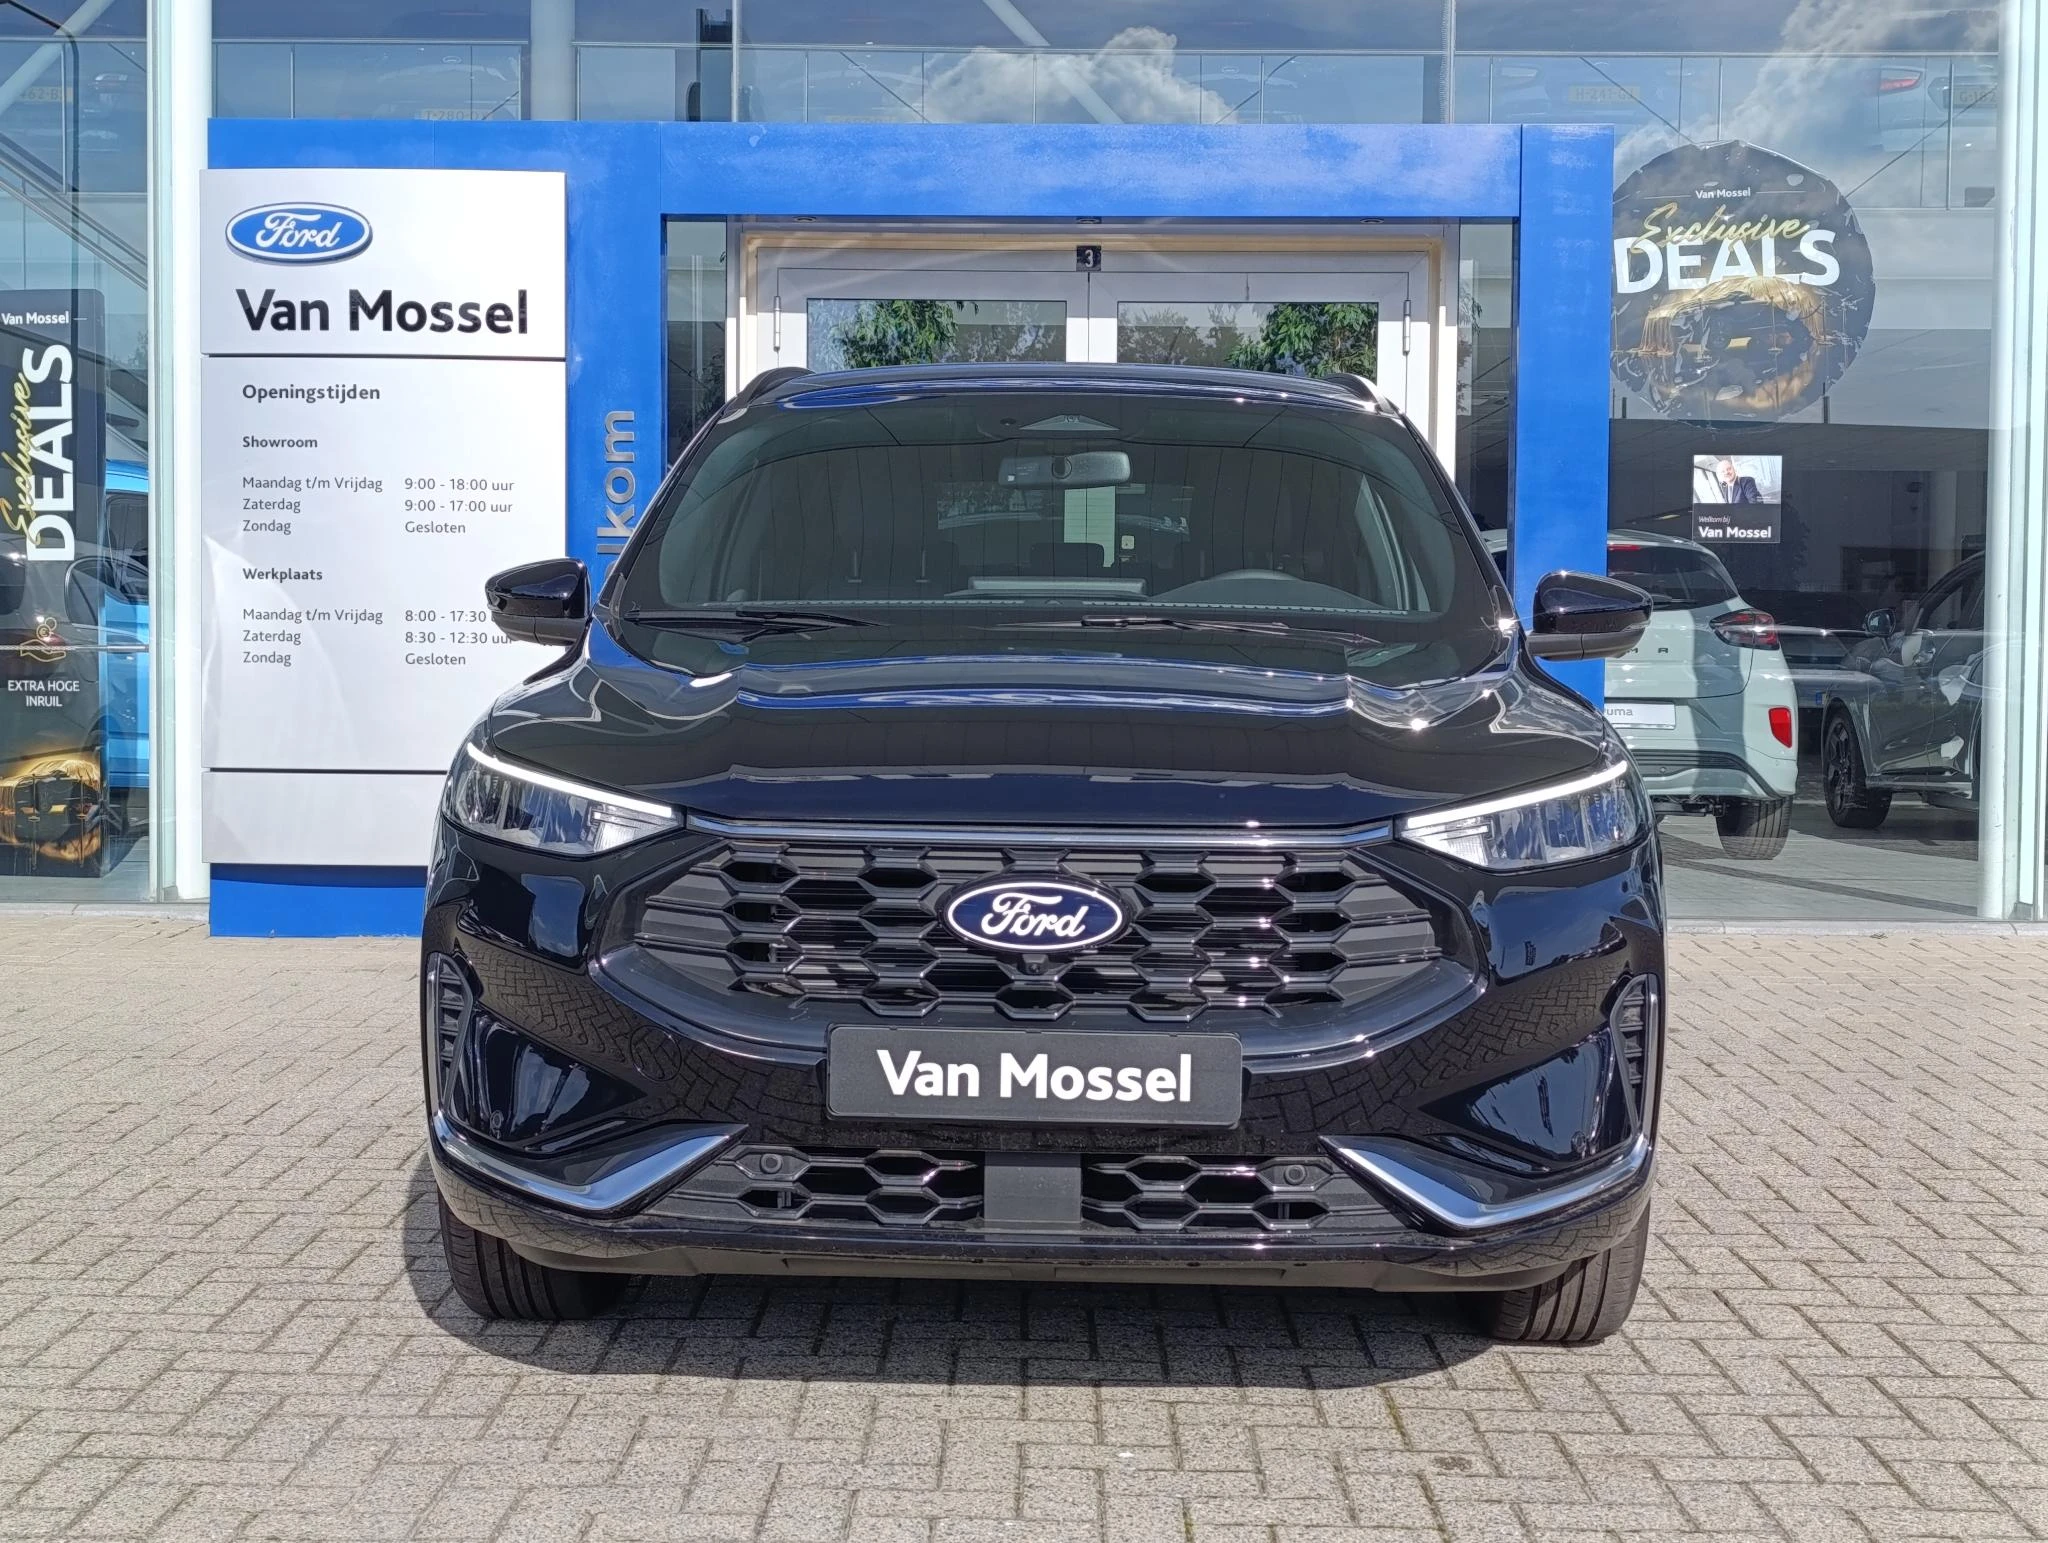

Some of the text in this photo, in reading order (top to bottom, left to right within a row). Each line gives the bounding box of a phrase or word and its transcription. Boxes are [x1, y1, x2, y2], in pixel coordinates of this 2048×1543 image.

[1695, 187, 1751, 200] Van Mossel
[255, 211, 343, 248] Ford
[1630, 201, 1812, 254] Exclusive
[1084, 249, 1094, 268] 3
[1612, 228, 1841, 295] DEALS
[1, 310, 70, 325] Van Mossel
[236, 288, 528, 335] Van Mossel
[242, 383, 381, 404] Openingstijden
[242, 434, 318, 449] Showroom
[22, 344, 75, 561] DEALS
[242, 476, 302, 493] Maandag
[305, 476, 331, 490] t/m
[334, 476, 383, 493] Vrijdag
[404, 477, 436, 490] 9:00
[449, 478, 488, 491] 18:00
[491, 482, 515, 492] uur
[242, 497, 301, 514] Zaterdag
[404, 499, 436, 512] 9:00
[449, 499, 487, 513] 17:00
[490, 502, 513, 514] uur
[242, 519, 466, 536] Zondag Gesloten
[1698, 525, 1772, 539] Van Mossel
[242, 567, 323, 584] Werkplaats
[242, 607, 303, 625] Maandag
[305, 608, 331, 622] t/m
[334, 608, 384, 625] Vrijdag
[404, 609, 437, 622] 8:00
[449, 610, 487, 623] 17:30
[242, 629, 302, 646] Zaterdag
[404, 631, 436, 644] 8:30
[449, 631, 488, 644] 12:30
[242, 650, 467, 668] Zondag Gesloten
[7, 680, 81, 692] EXTRA HOGE
[25, 695, 63, 707] INRUIL
[981, 892, 1089, 937] Ford
[876, 1049, 1192, 1104] Van Mossel
